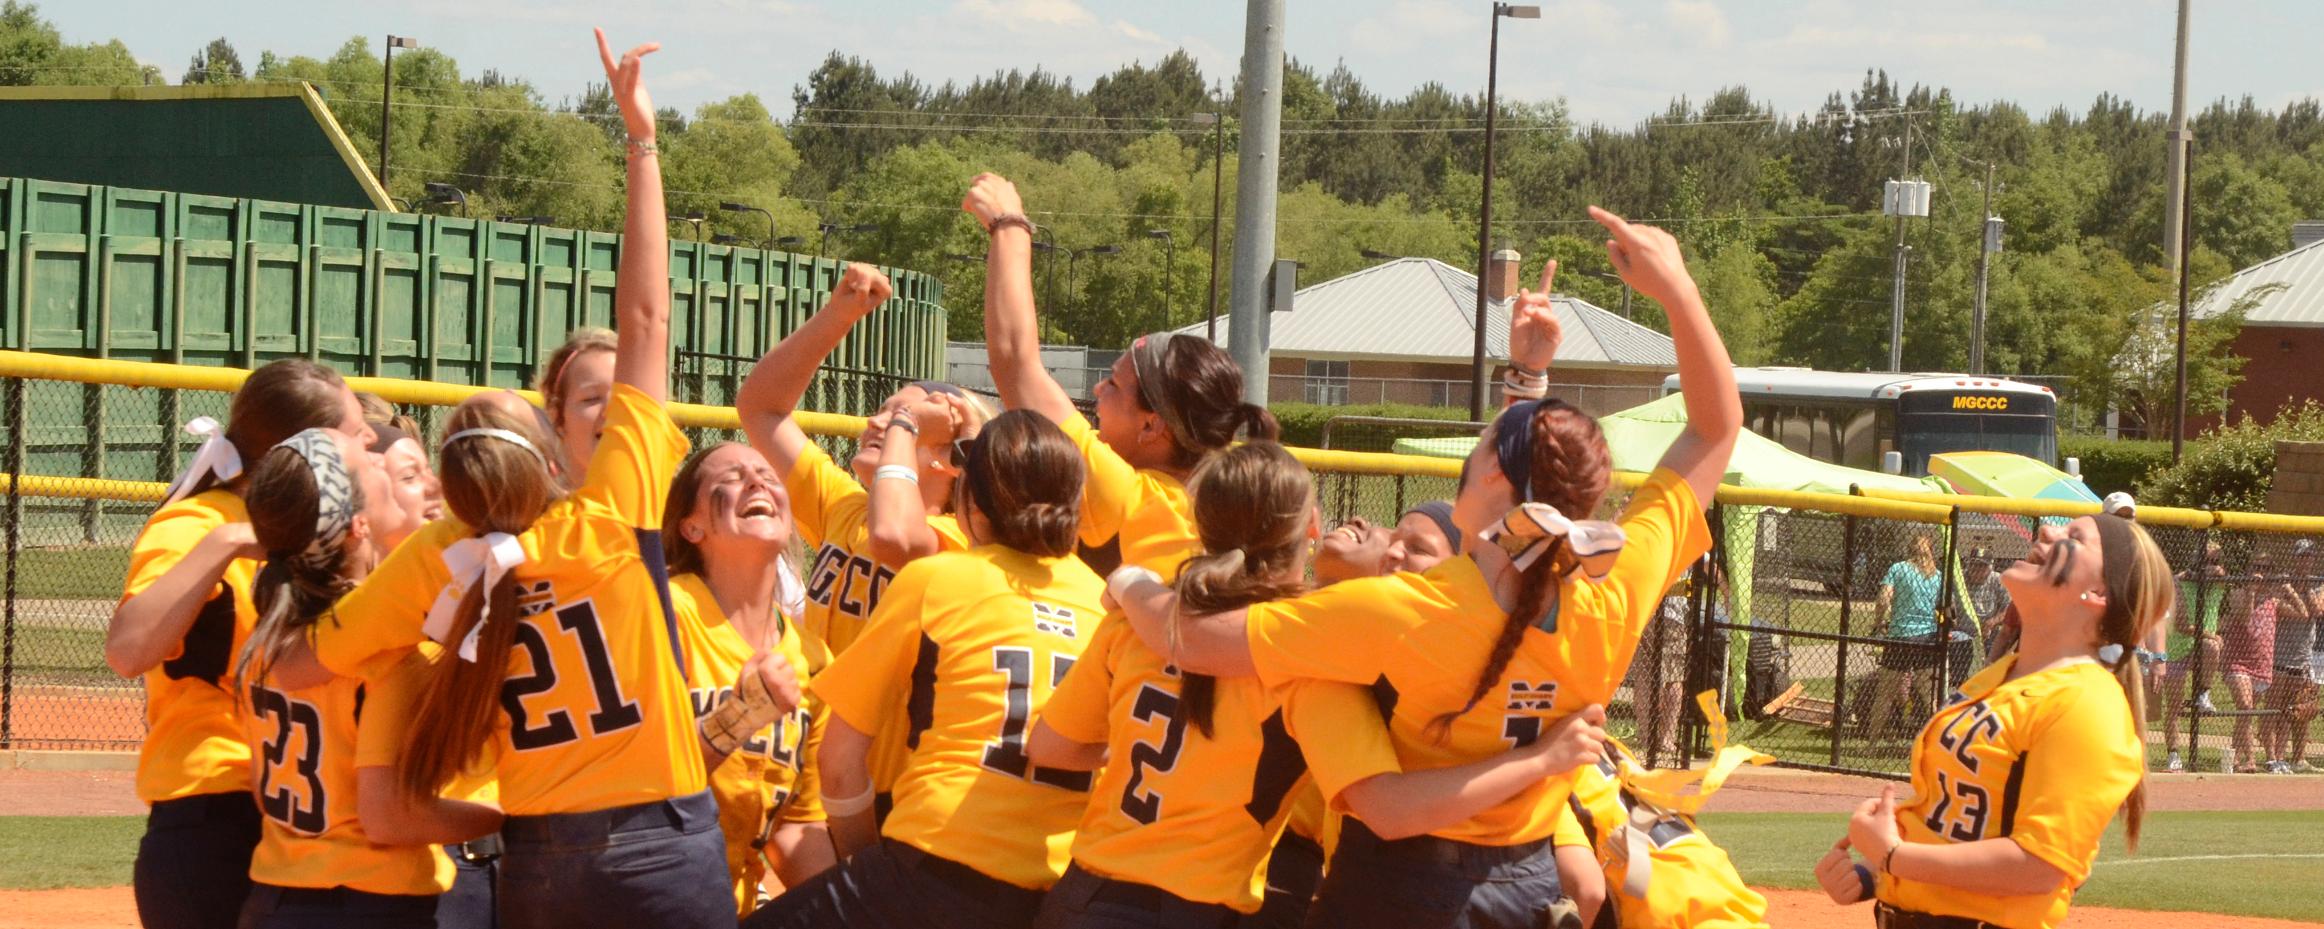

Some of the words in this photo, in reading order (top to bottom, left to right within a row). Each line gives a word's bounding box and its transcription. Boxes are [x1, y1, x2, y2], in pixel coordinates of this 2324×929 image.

[1952, 396, 2008, 410] MGCCC
[500, 597, 643, 752] 21
[249, 684, 328, 835] 23
[1119, 682, 1190, 827] 2
[1925, 770, 1989, 843] 13
